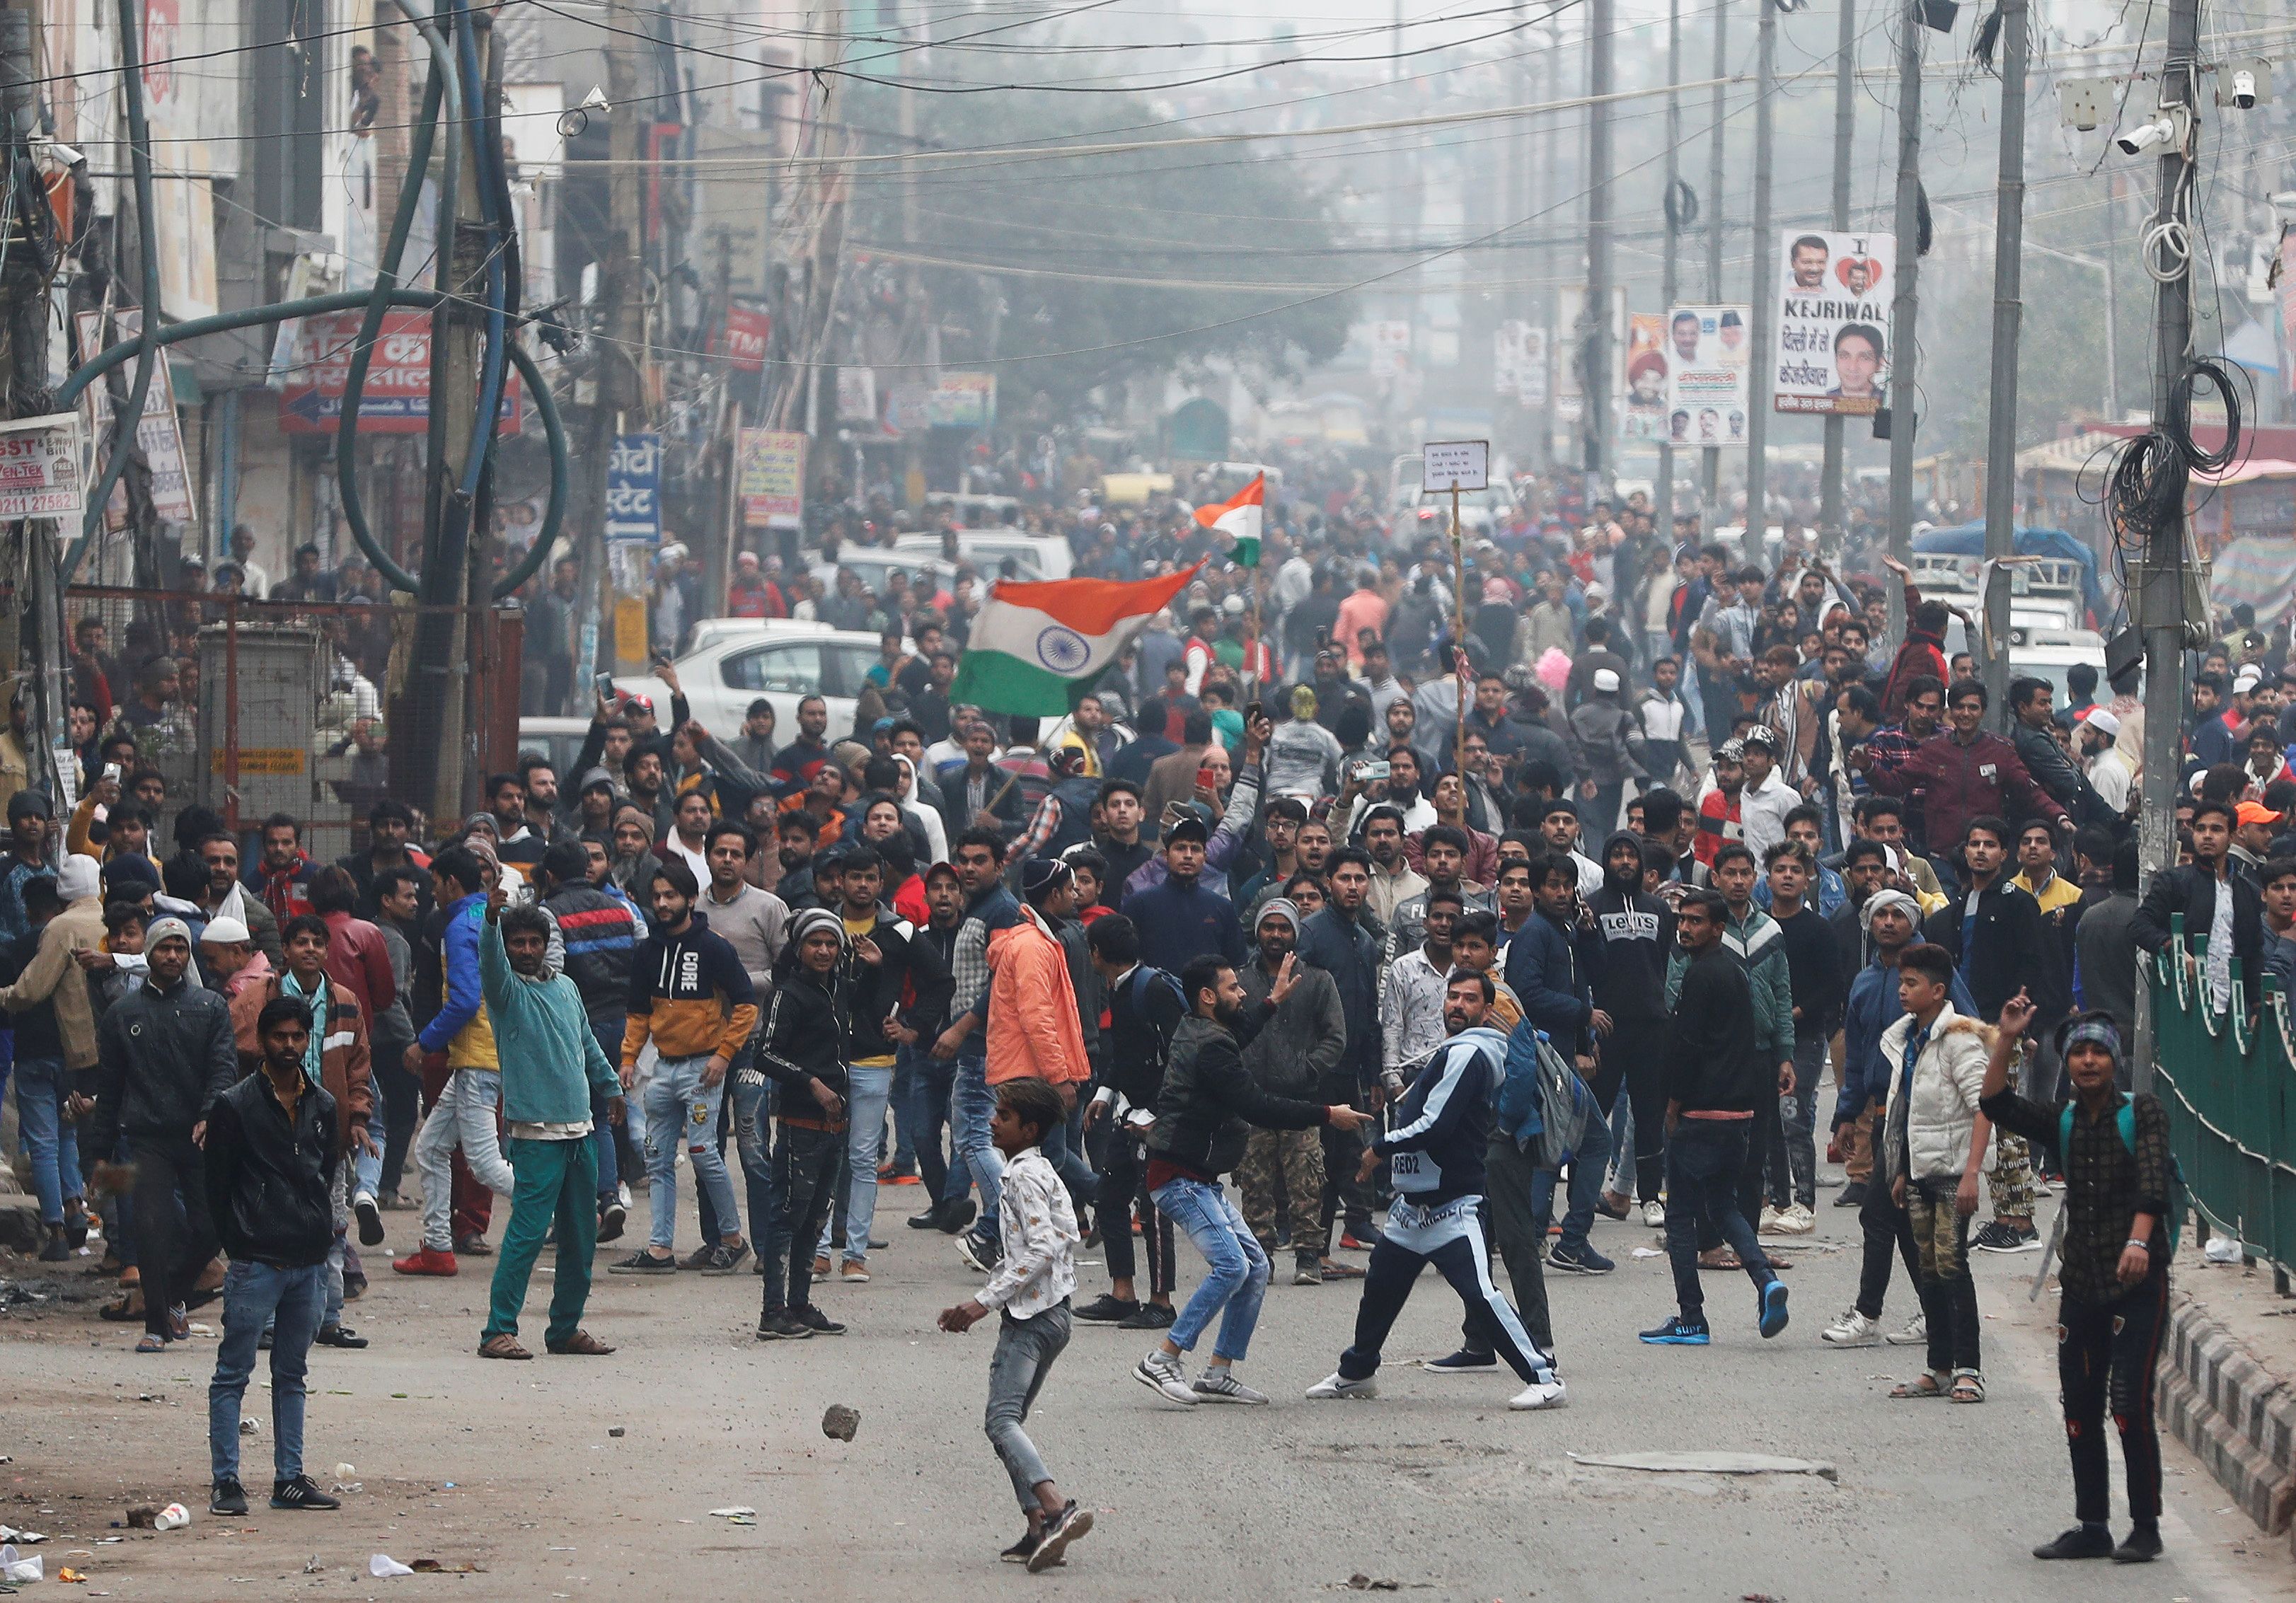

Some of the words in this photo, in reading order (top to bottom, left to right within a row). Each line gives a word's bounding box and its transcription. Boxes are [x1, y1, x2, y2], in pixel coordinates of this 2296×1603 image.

[1852, 238, 1869, 254] I
[1784, 299, 1885, 320] KEJRIWAL
[681, 951, 699, 991] CORE
